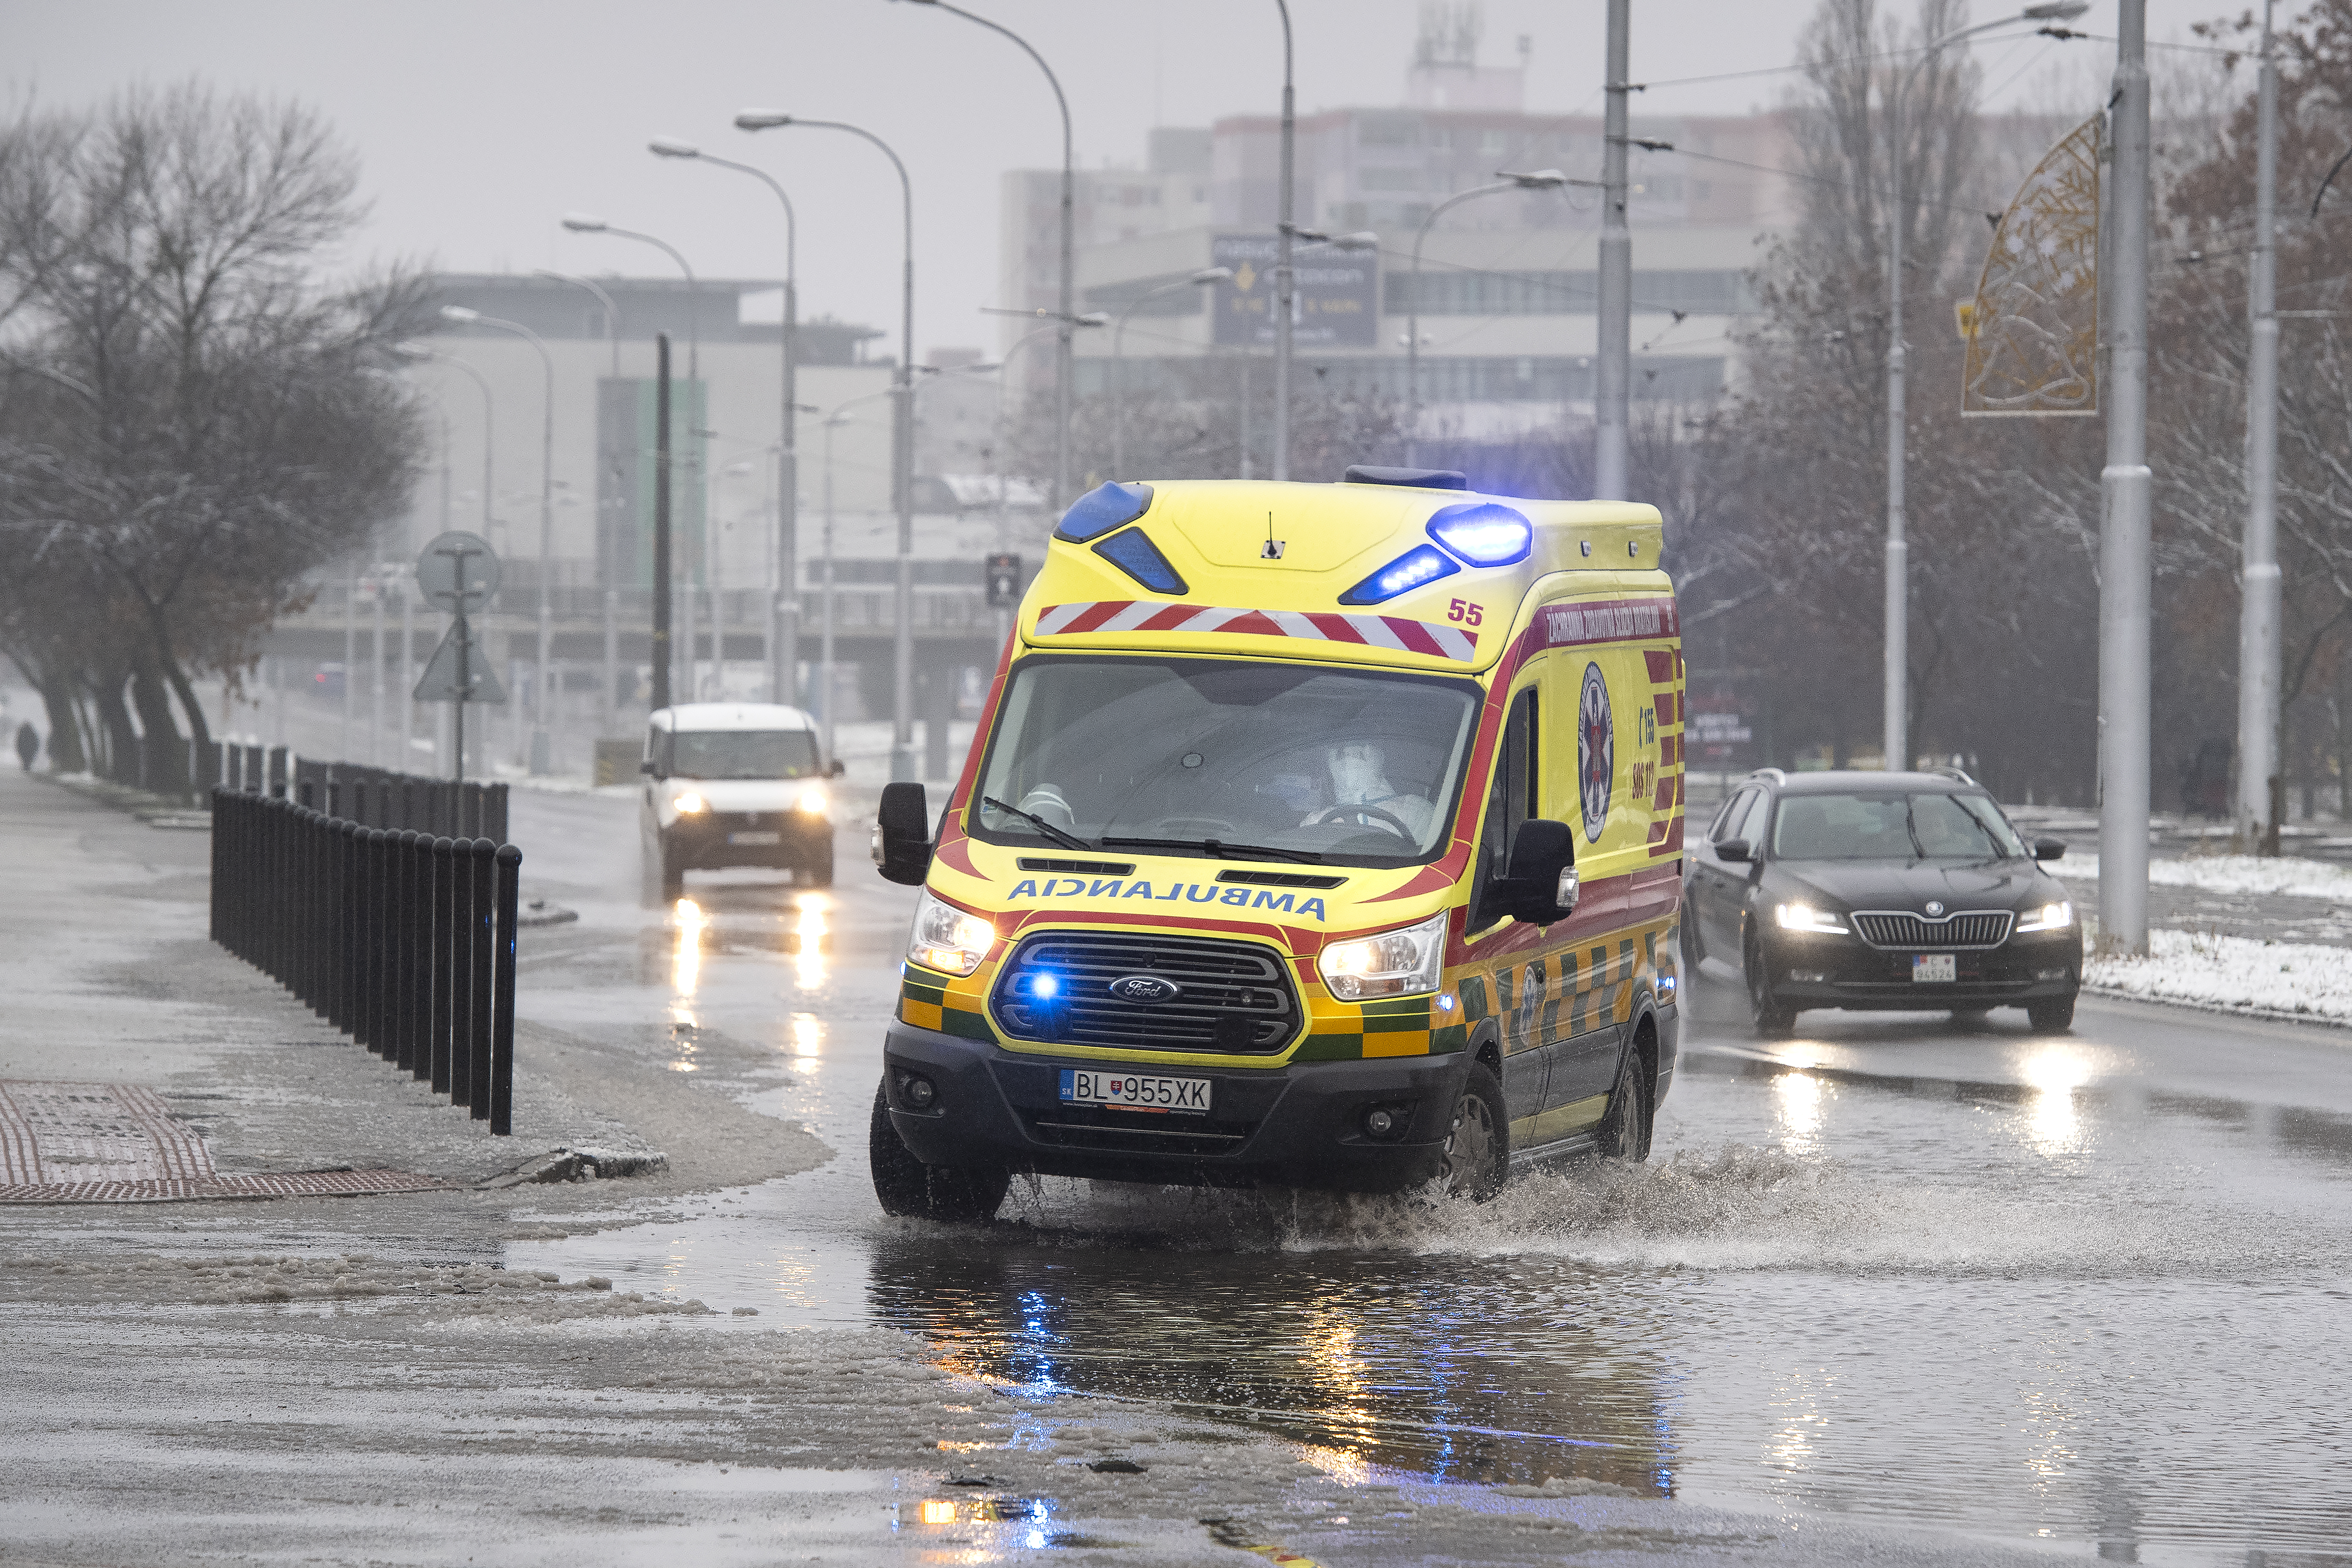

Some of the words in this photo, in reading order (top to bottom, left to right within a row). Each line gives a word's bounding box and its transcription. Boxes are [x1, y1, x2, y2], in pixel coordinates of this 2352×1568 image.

[1448, 598, 1483, 626] 55
[1644, 708, 1654, 744] 155
[1633, 762, 1644, 799] SOS
[1646, 761, 1654, 797] 112
[1125, 980, 1161, 996] Ford
[1078, 1073, 1108, 1100] BL
[1124, 1077, 1206, 1107] 955XK
